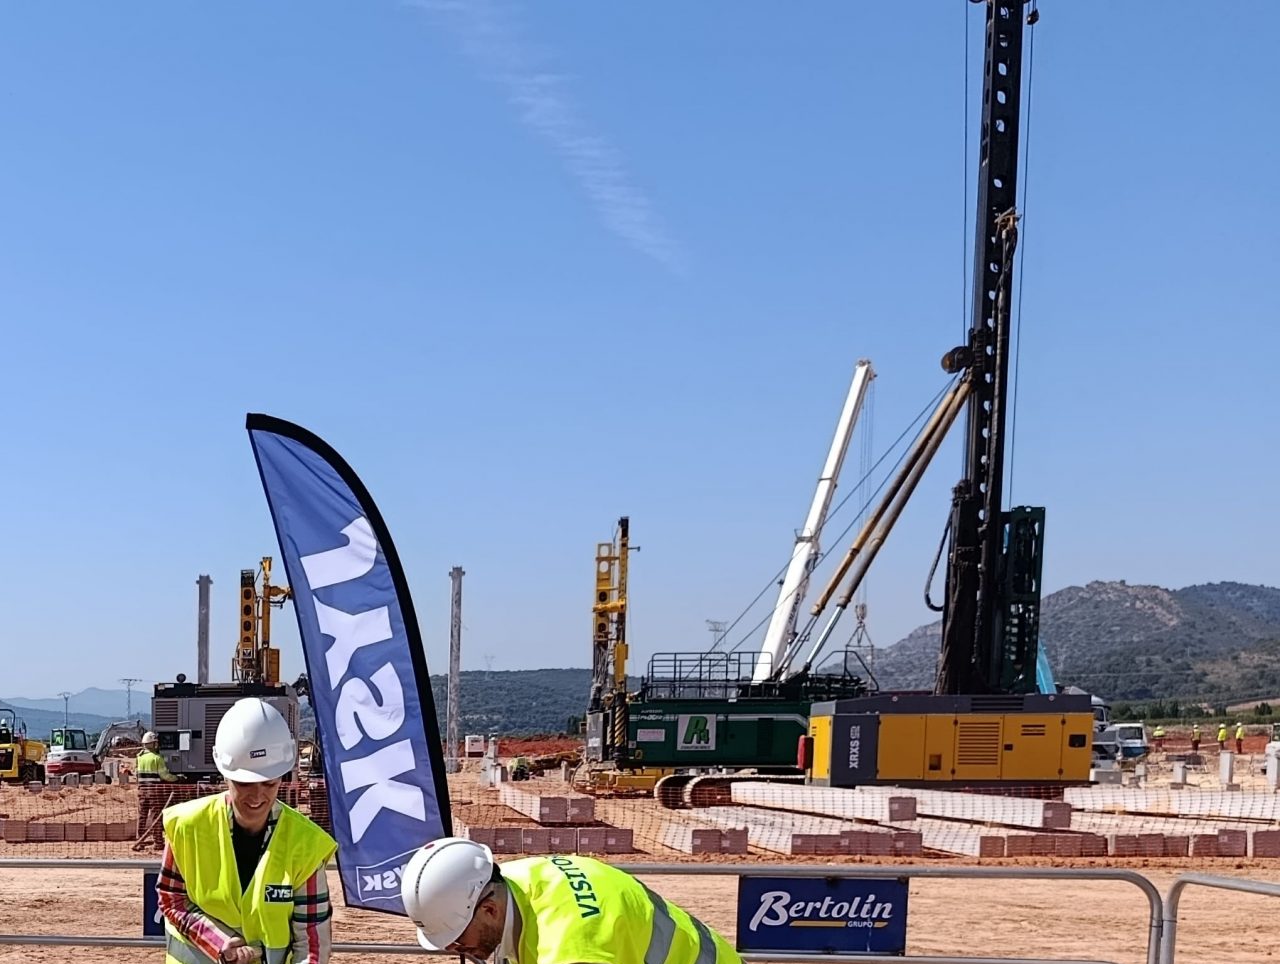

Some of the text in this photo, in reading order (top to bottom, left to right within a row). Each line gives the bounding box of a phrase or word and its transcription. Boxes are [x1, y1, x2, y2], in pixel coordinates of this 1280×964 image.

[849, 740, 860, 769] XRXS
[548, 855, 600, 918] VISITO
[847, 920, 873, 928] GRUPO
